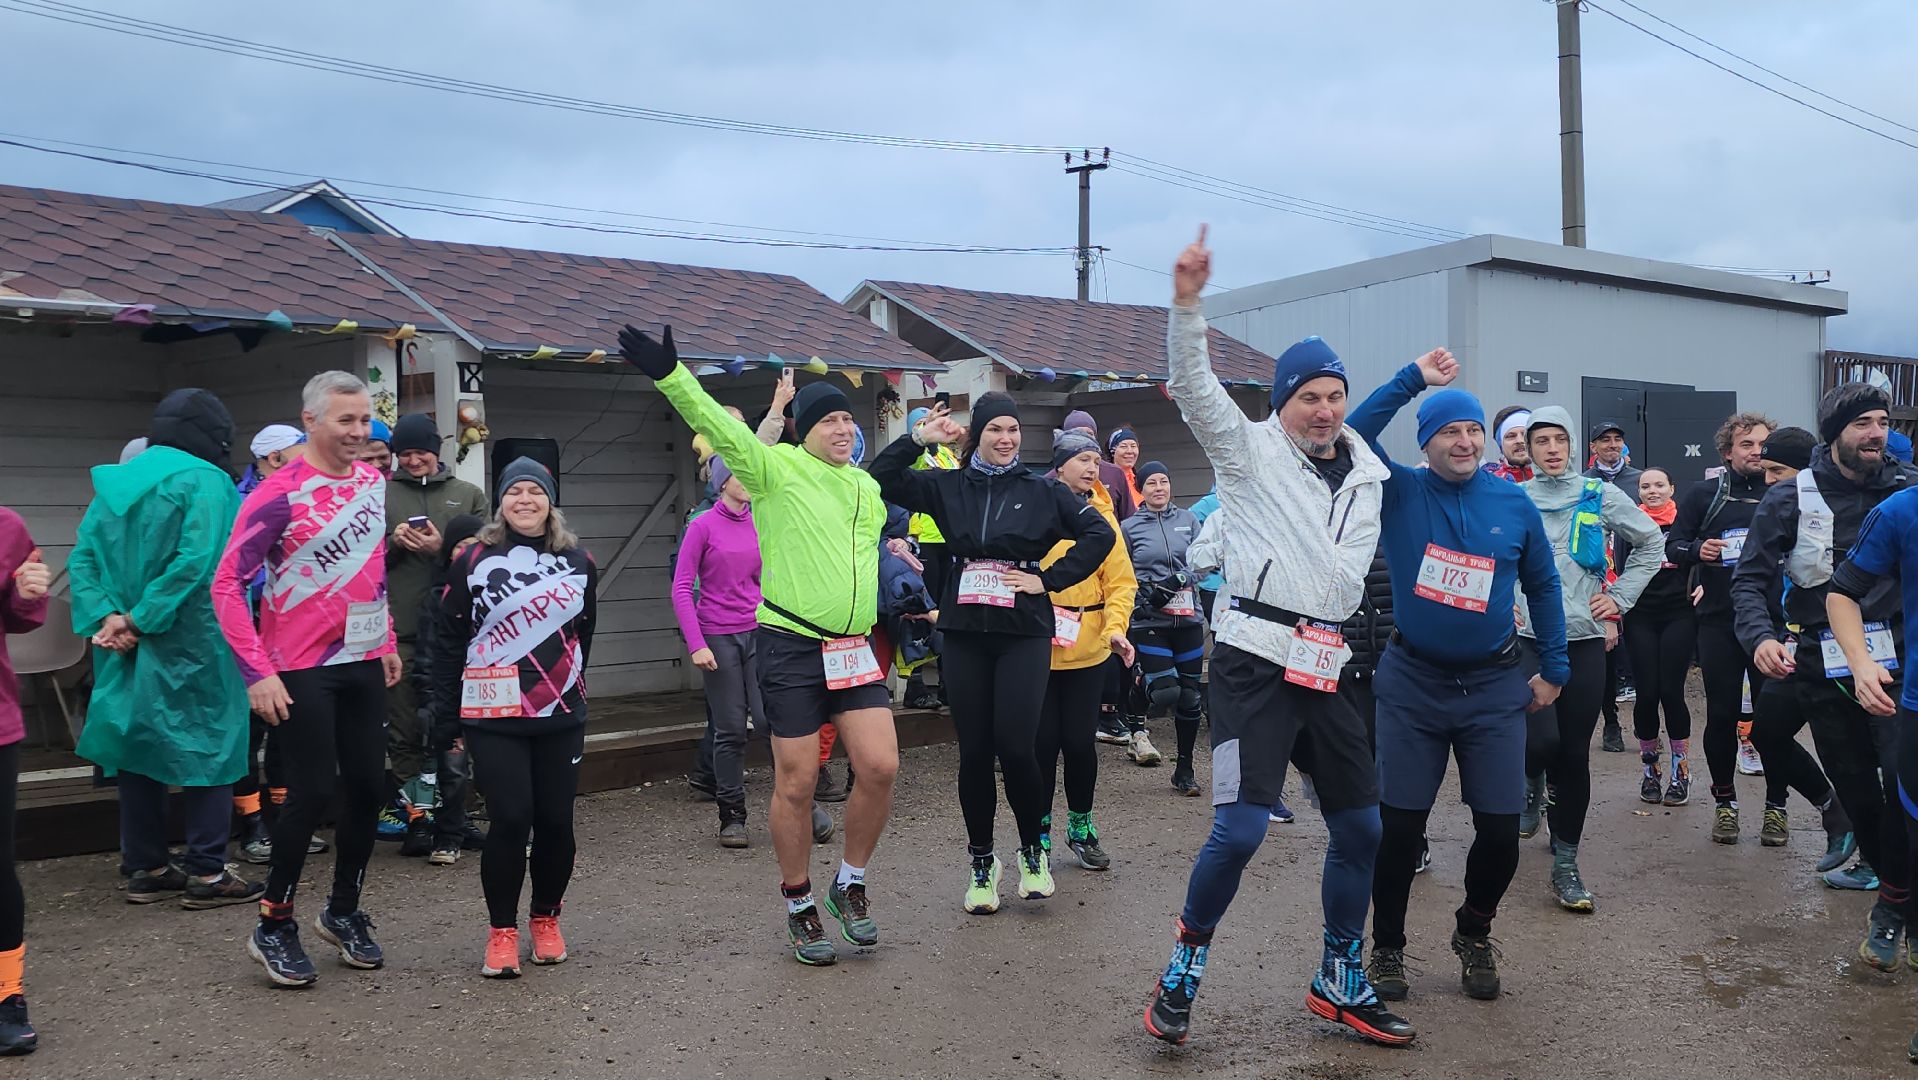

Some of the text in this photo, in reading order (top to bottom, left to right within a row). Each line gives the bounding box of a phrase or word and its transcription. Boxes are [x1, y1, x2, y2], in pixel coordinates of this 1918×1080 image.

[1684, 444, 1702, 457] Ж
[974, 574, 999, 588] 299
[1441, 566, 1469, 588] 173
[488, 581, 584, 652] АНГАРКА
[843, 652, 859, 670] 194
[479, 682, 497, 700] 185
